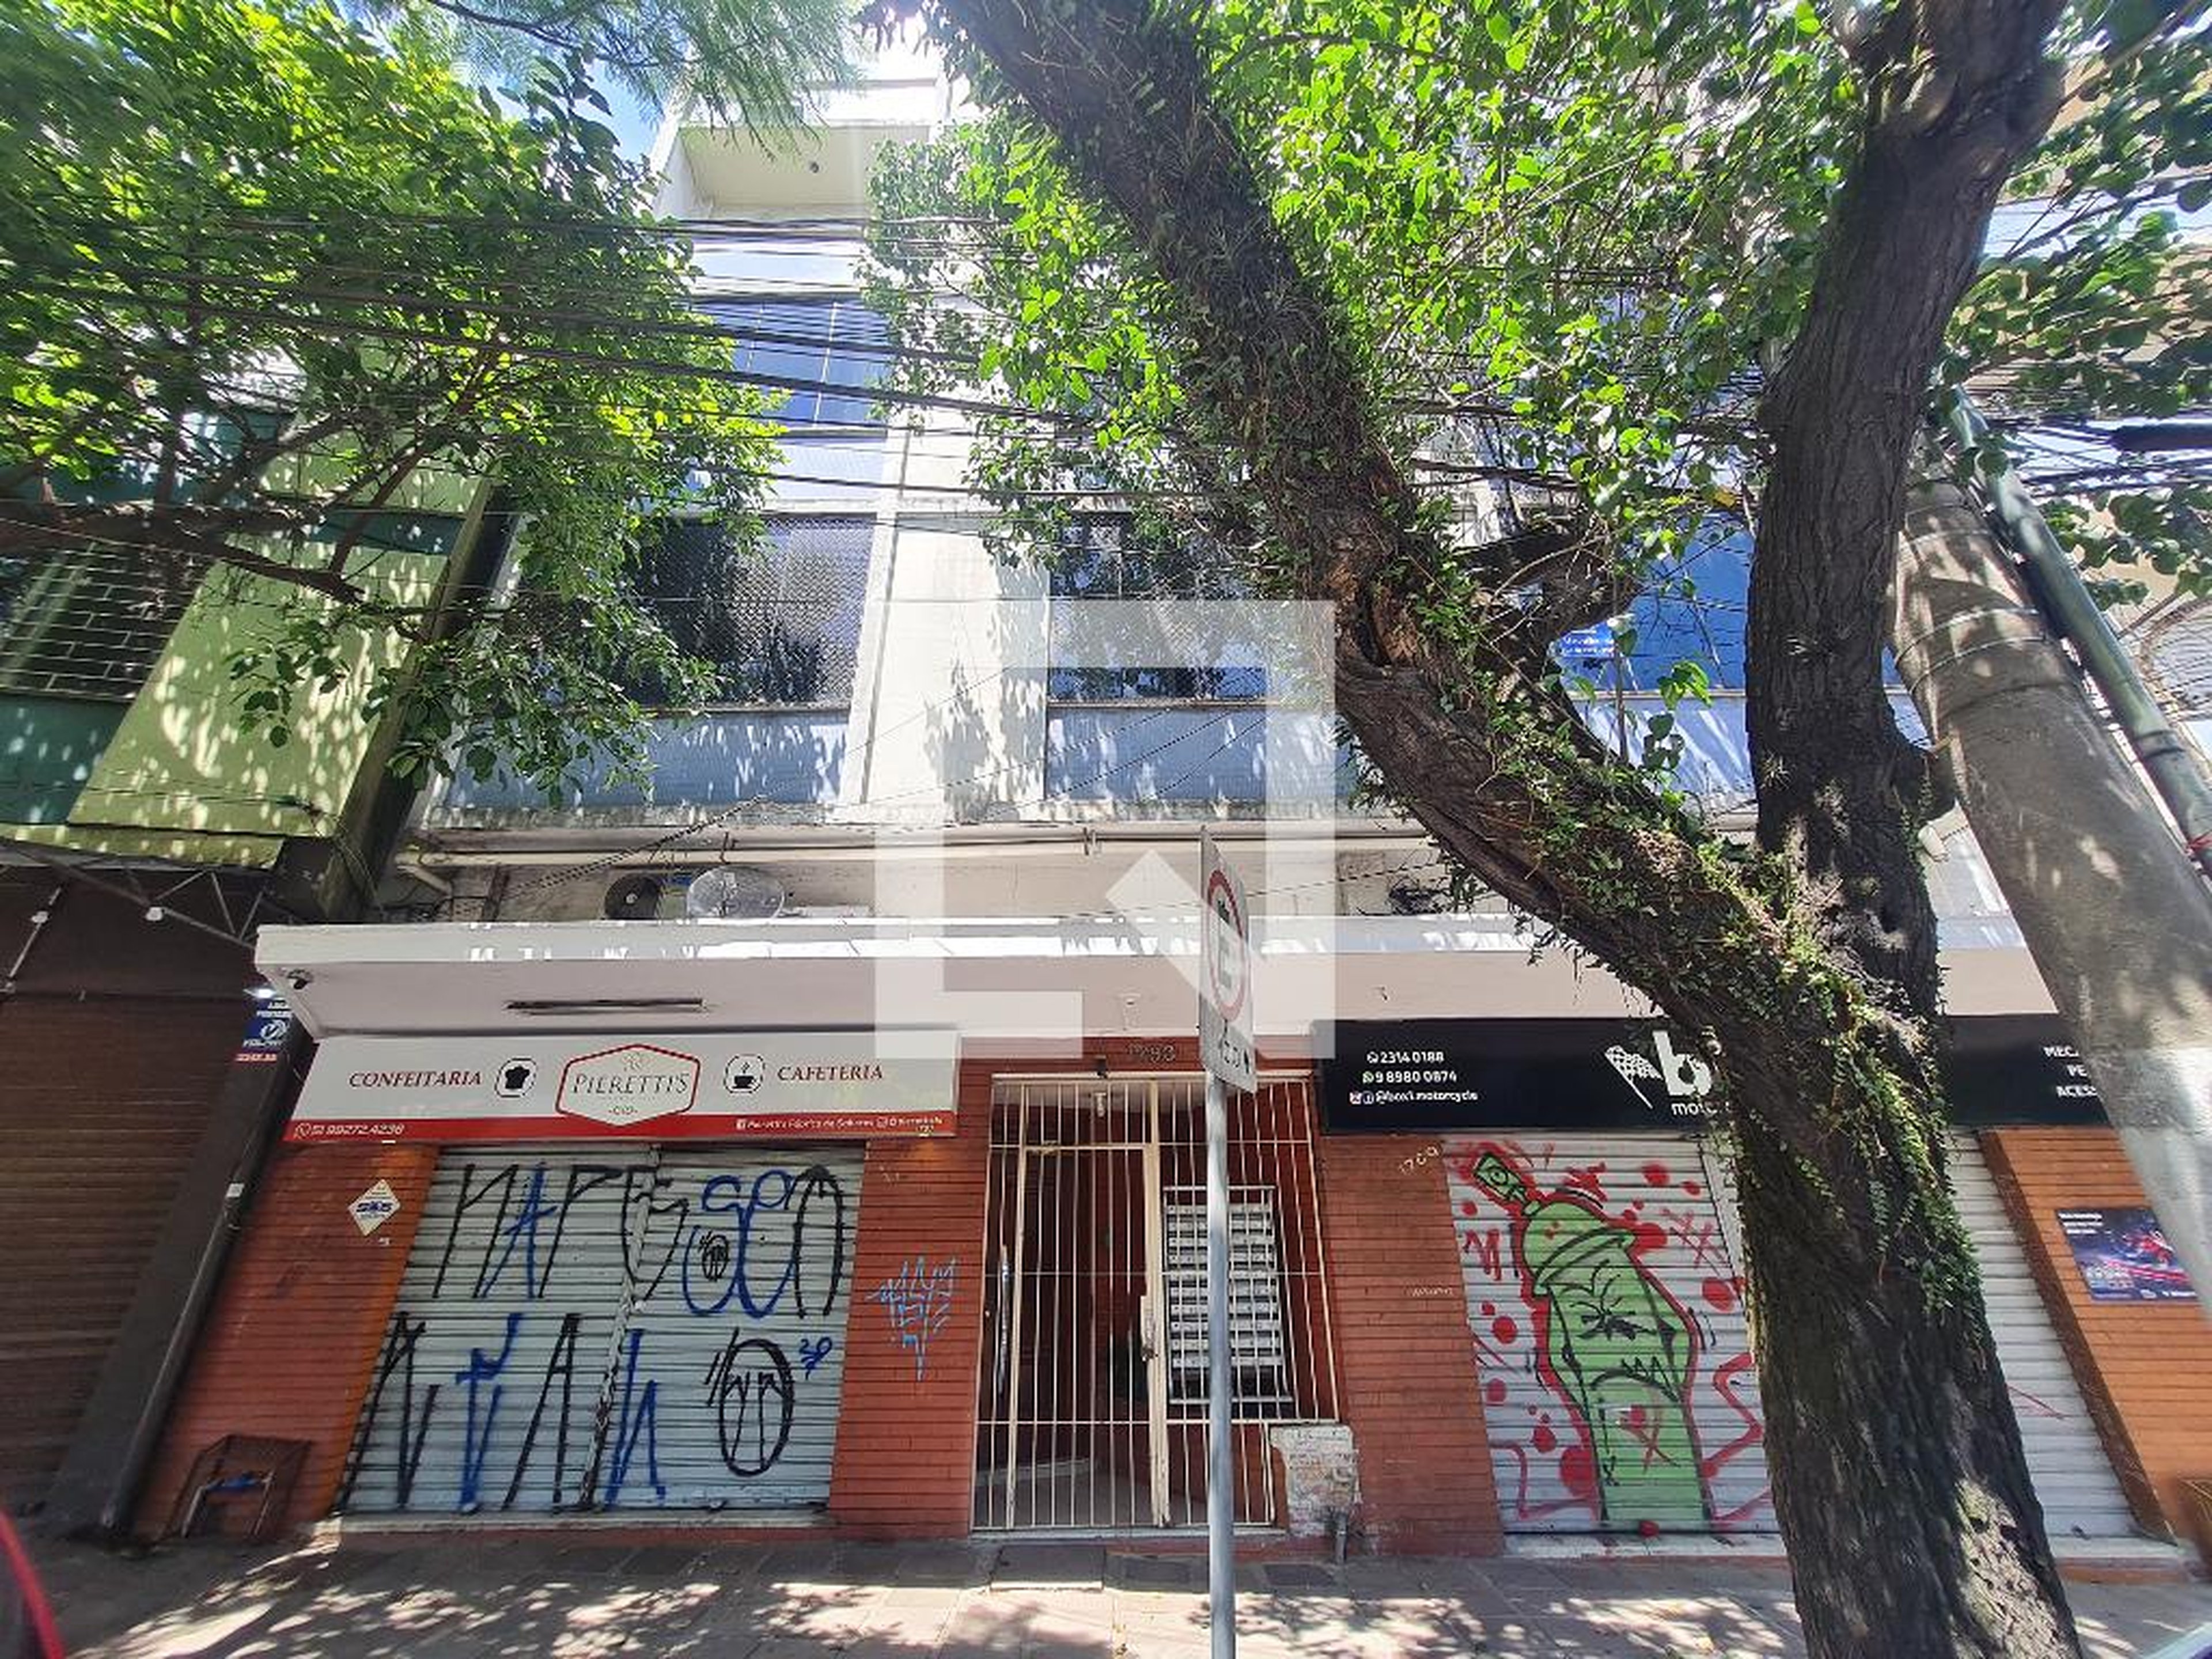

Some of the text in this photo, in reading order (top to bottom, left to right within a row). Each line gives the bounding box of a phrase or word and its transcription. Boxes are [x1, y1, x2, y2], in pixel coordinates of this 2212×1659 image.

[1380, 1051, 1444, 1064] 2314 0188
[777, 1065, 883, 1081] CAFETERIA
[1375, 1070, 1384, 1084] 9
[1386, 1070, 1422, 1084] 8980
[2066, 1063, 2088, 1077] PE
[349, 1070, 482, 1088] CONFEITARIA
[2055, 1085, 2098, 1097] ACESS
